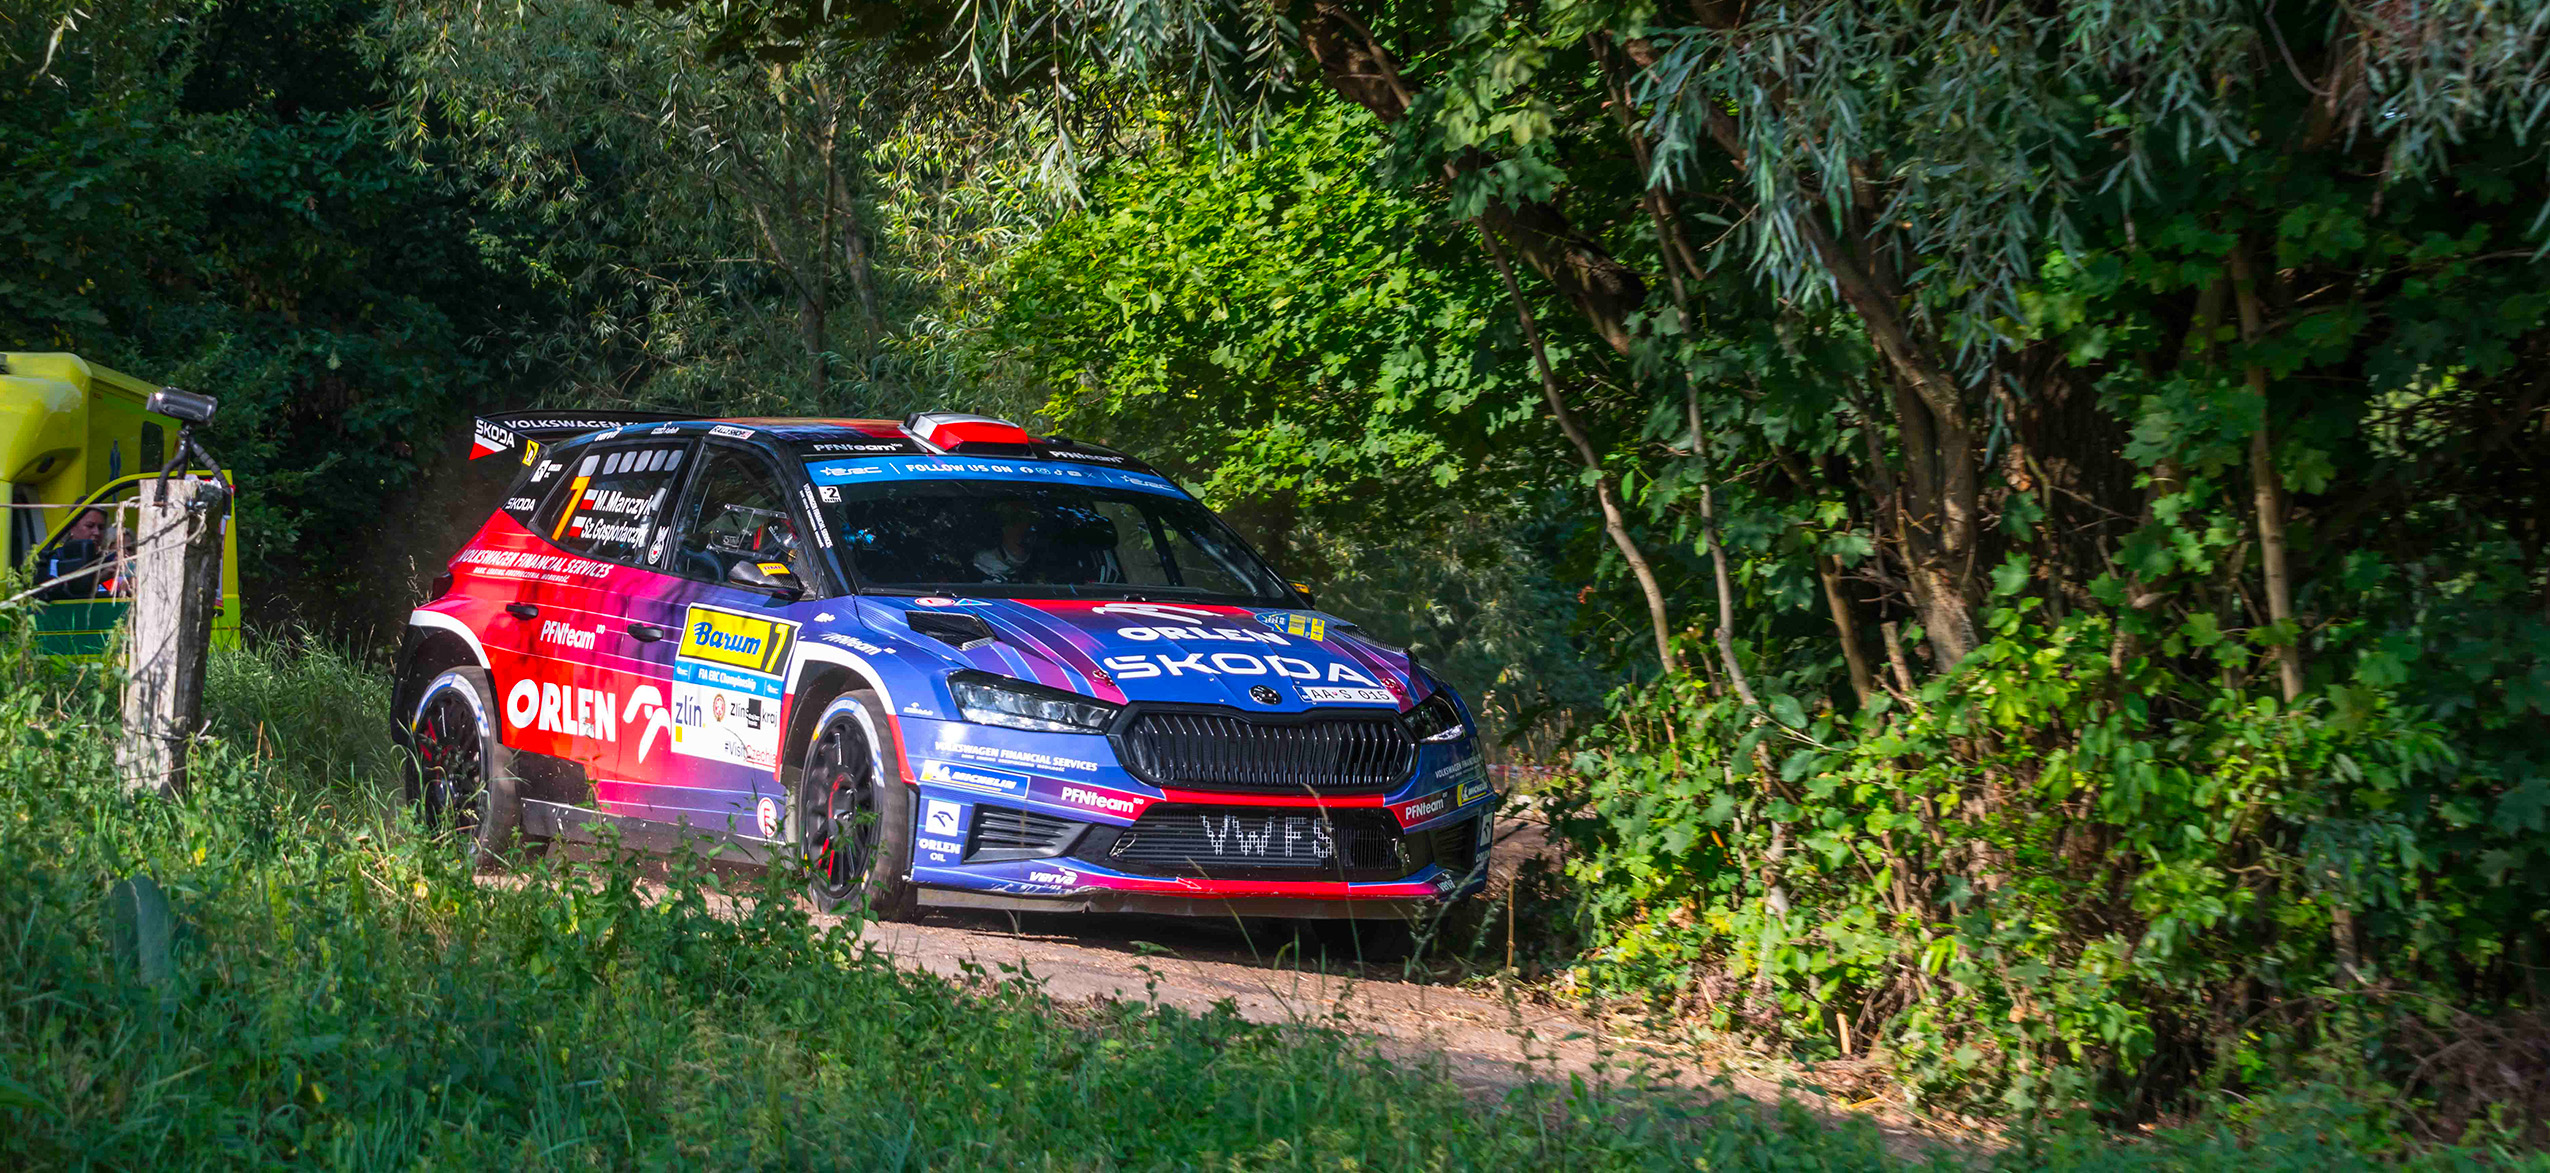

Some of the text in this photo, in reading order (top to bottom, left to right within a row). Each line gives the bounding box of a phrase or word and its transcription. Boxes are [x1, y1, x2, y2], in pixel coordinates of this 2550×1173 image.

[504, 419, 620, 429] VOLKSWAGEN
[905, 464, 965, 472] FOLLOW
[991, 465, 1013, 473] ON
[551, 476, 591, 541] 1
[592, 490, 654, 520] M.Marczyk
[458, 549, 614, 578] VOLKSWAGEN FINANCIAL SERVICES
[1117, 626, 1291, 646] ORLEN
[694, 622, 790, 673] Barum 1
[1310, 689, 1390, 701] AA S 015
[506, 678, 616, 743] ORLEN
[762, 708, 778, 727] kraj
[935, 741, 999, 757] VOLKSWAGEN
[1000, 749, 1052, 765] FINANCIAL
[1053, 757, 1098, 772] SERVICES
[951, 771, 1017, 790] MICHELIN
[1061, 787, 1134, 813] PFNteam
[918, 838, 961, 854] ORLEN
[930, 852, 946, 862] OIL
[1029, 870, 1078, 885] verva
